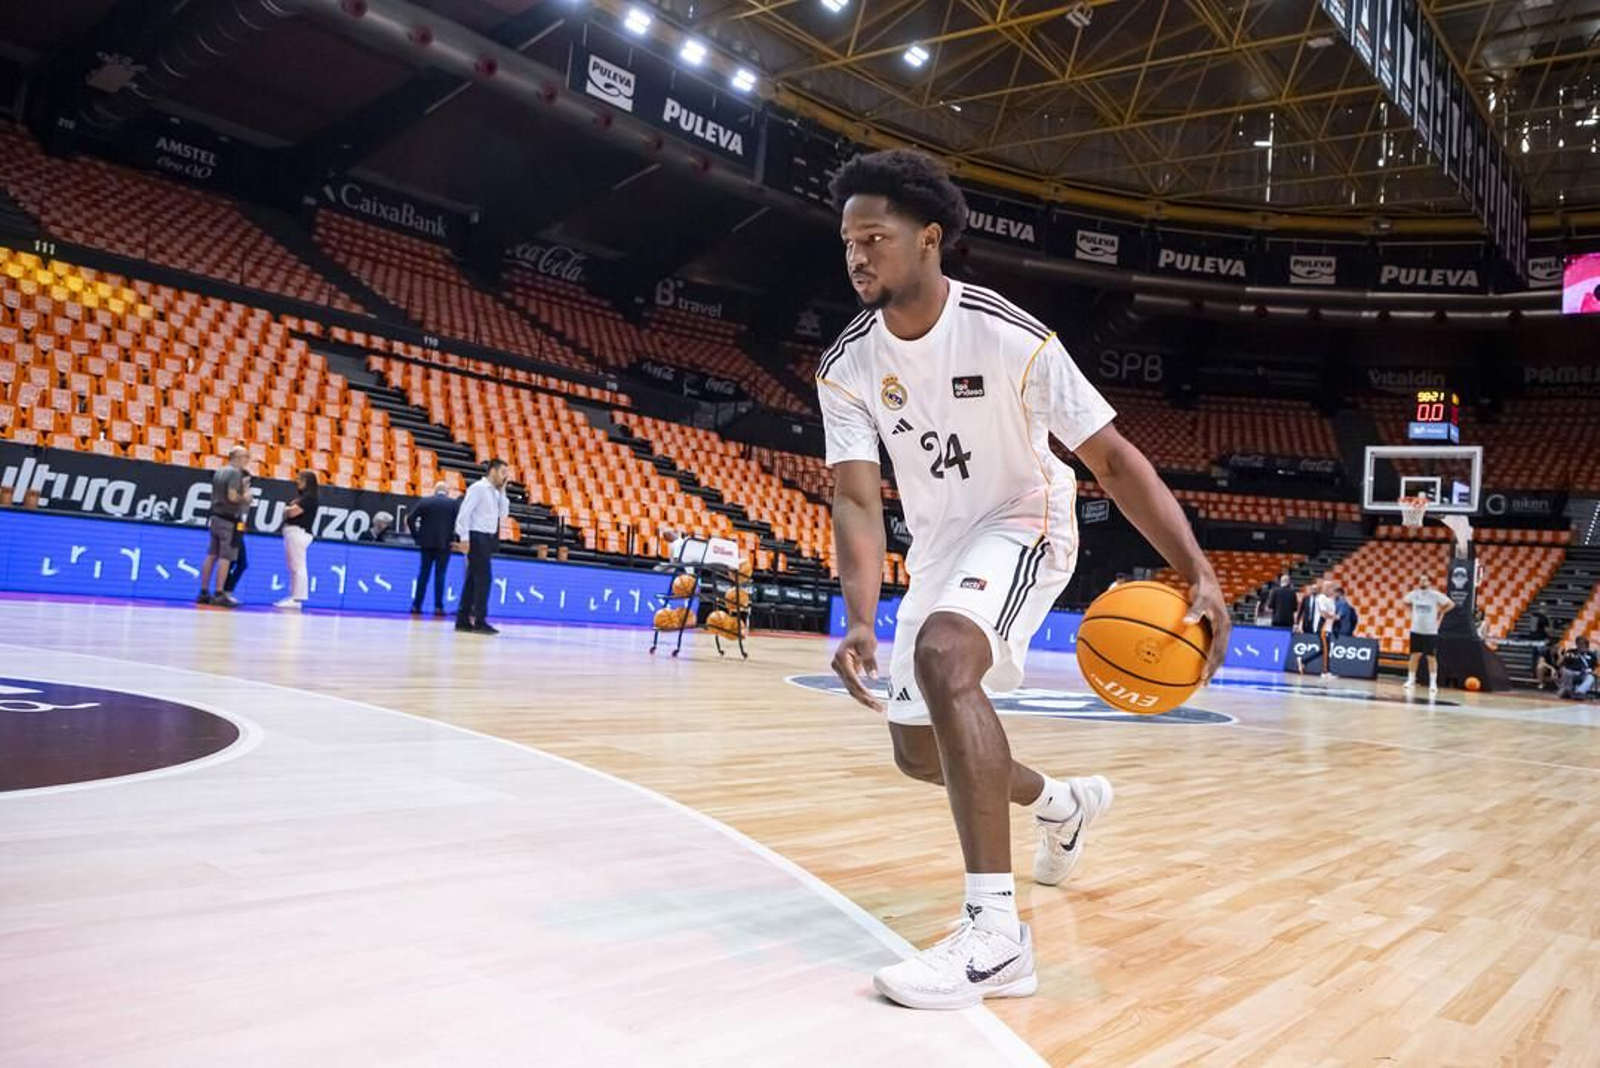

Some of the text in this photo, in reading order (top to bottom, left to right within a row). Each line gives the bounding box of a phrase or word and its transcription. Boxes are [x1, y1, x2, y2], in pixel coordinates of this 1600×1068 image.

[592, 61, 632, 89] PULEVA
[663, 97, 744, 157] PULEVA
[155, 136, 217, 167] AMSTEL
[340, 184, 448, 238] CaixaBank
[966, 208, 1036, 243] ULEVA
[1079, 232, 1117, 248] PULEVA
[1158, 249, 1246, 277] PULEVA
[1293, 258, 1334, 269] PULEVA
[1380, 265, 1480, 287] PULEVA
[678, 296, 723, 318] travel
[1099, 351, 1164, 382] SPB
[920, 431, 971, 480] 24
[136, 494, 179, 519] del
[1104, 681, 1159, 707] EVO
